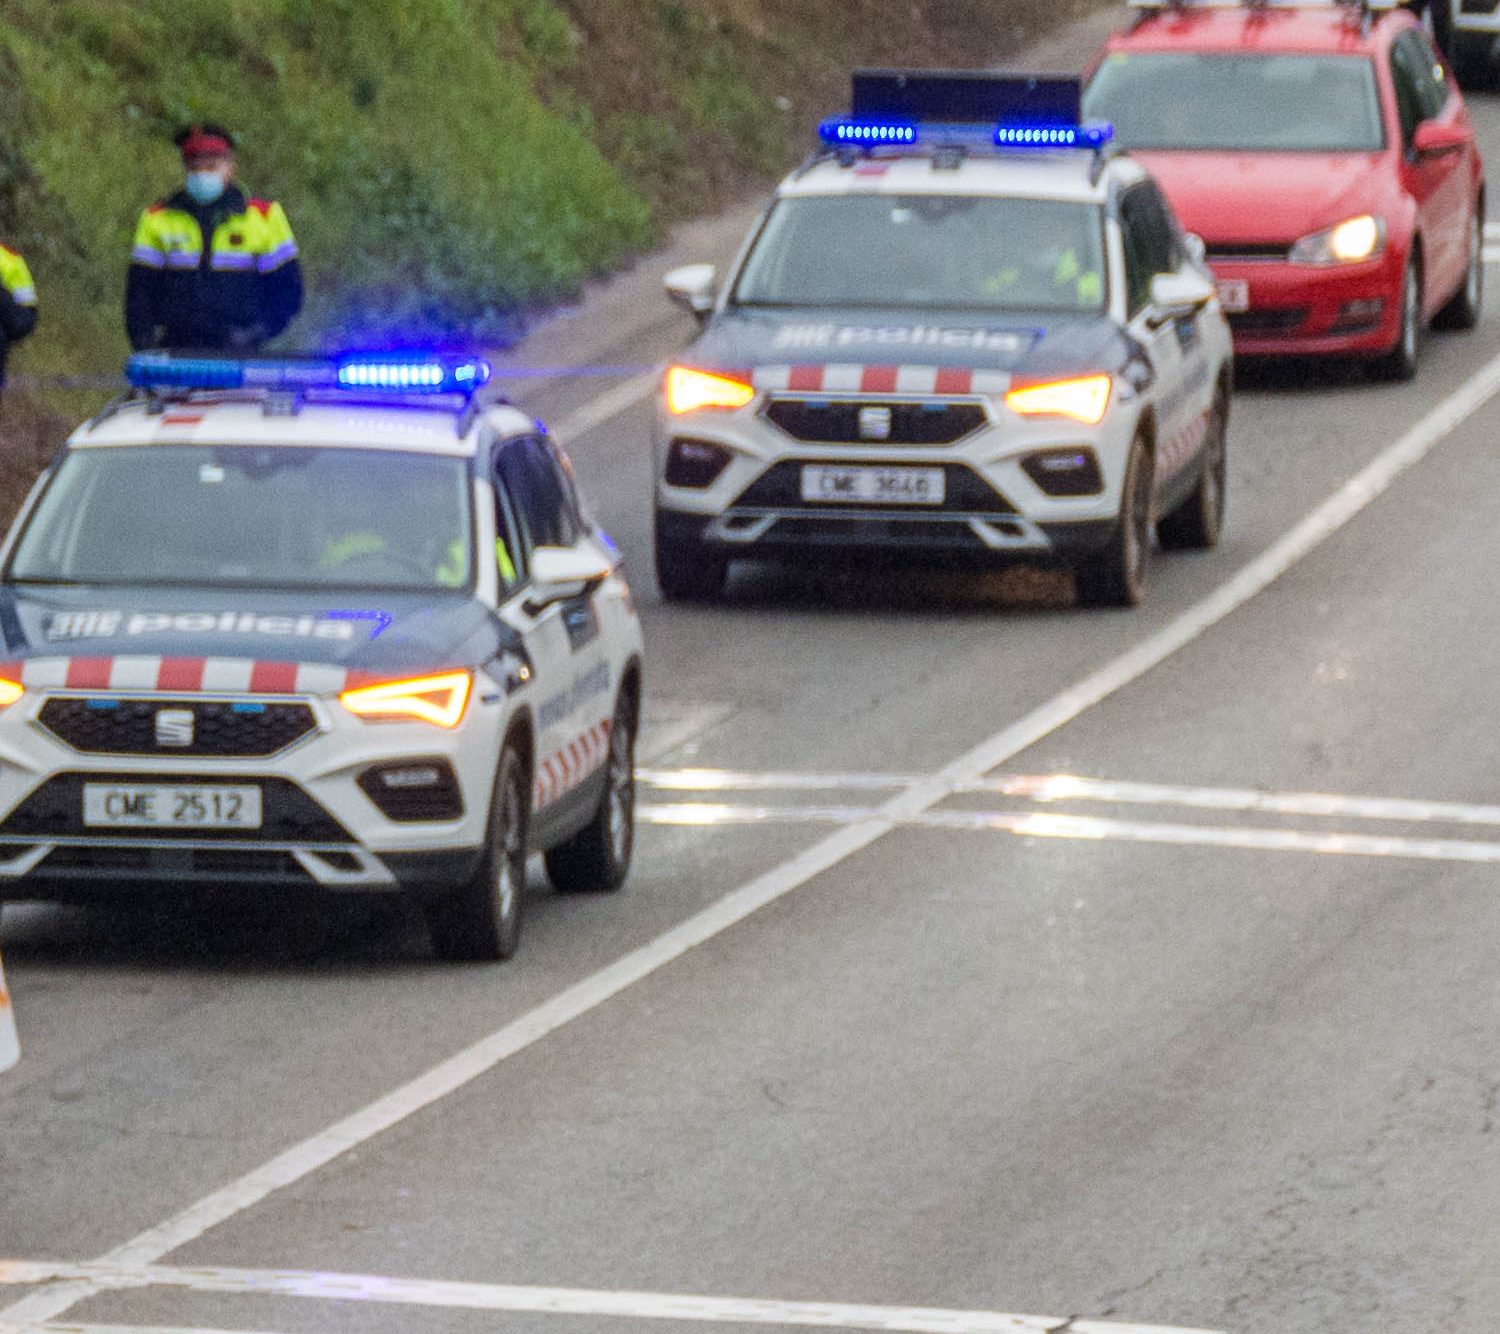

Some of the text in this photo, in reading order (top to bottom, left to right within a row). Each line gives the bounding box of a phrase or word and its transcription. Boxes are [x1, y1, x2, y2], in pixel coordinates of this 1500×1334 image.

[126, 609, 356, 642] policia
[104, 791, 244, 821] CME 2512
